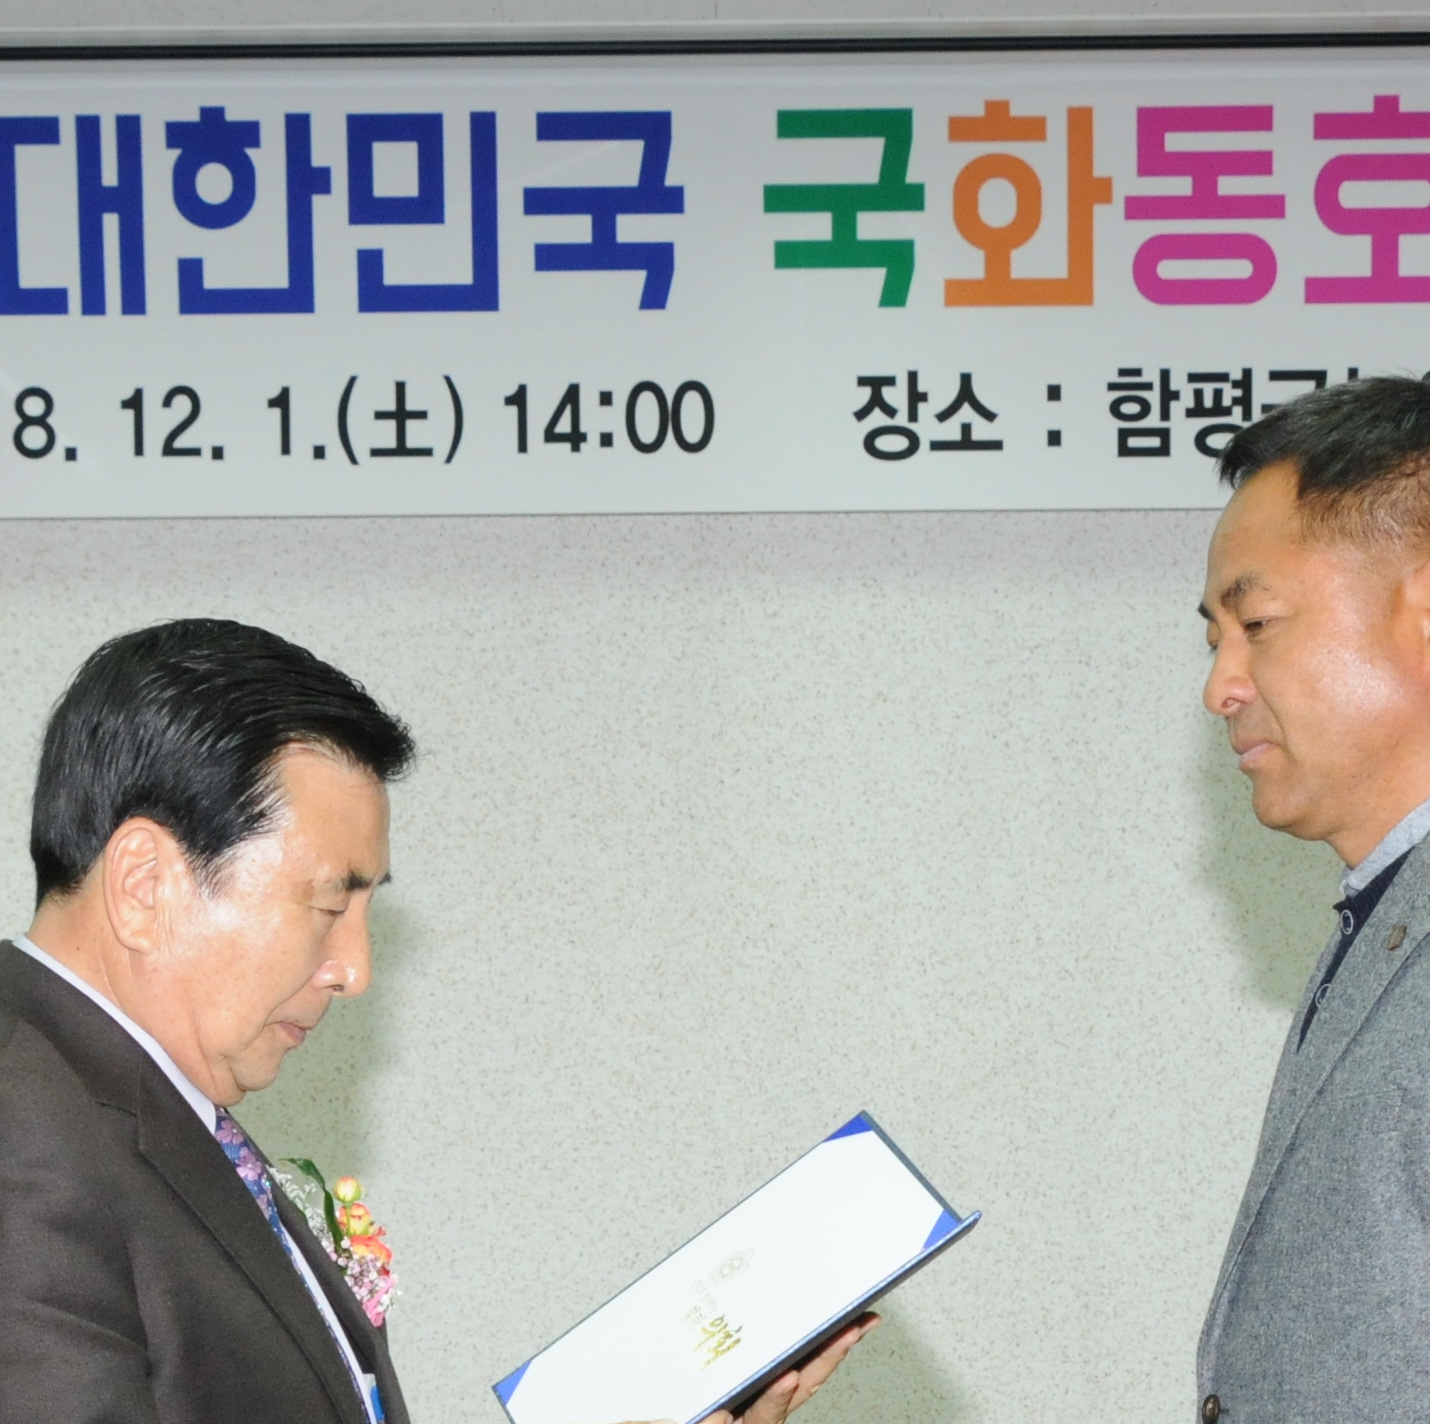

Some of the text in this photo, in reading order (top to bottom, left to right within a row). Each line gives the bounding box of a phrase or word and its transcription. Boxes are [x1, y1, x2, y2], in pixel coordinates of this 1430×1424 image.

[120, 385, 224, 461] 12.
[504, 381, 715, 454] 14:00
[853, 370, 1004, 461] 장소
[1047, 384, 1062, 447] :
